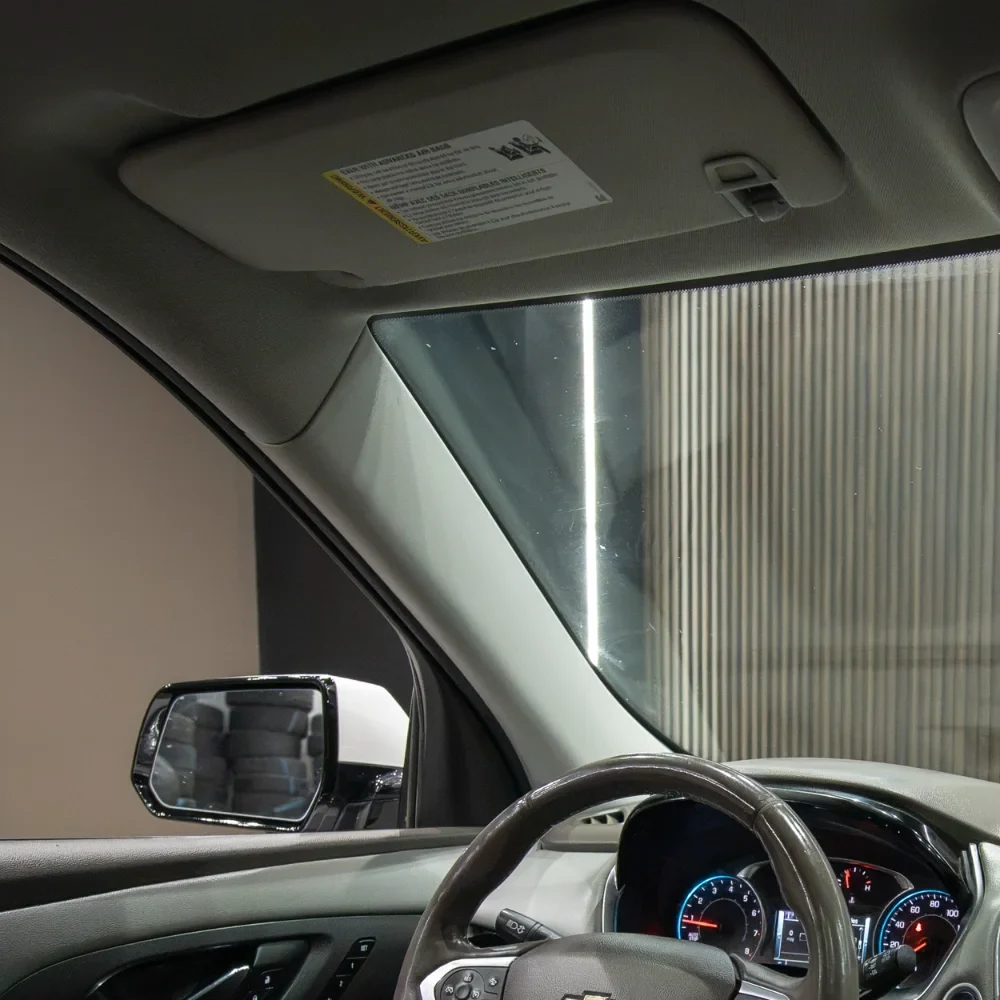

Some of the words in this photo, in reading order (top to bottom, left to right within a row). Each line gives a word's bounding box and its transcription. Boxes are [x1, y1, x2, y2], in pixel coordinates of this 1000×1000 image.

[712, 887, 717, 895] 3
[743, 894, 748, 902] 5
[929, 899, 940, 908] 80
[751, 909, 757, 917] 6
[910, 905, 921, 914] 60
[946, 908, 960, 918] 100
[894, 920, 905, 929] 40
[753, 929, 758, 937] 7
[889, 941, 900, 949] 20
[744, 947, 749, 955] 8
